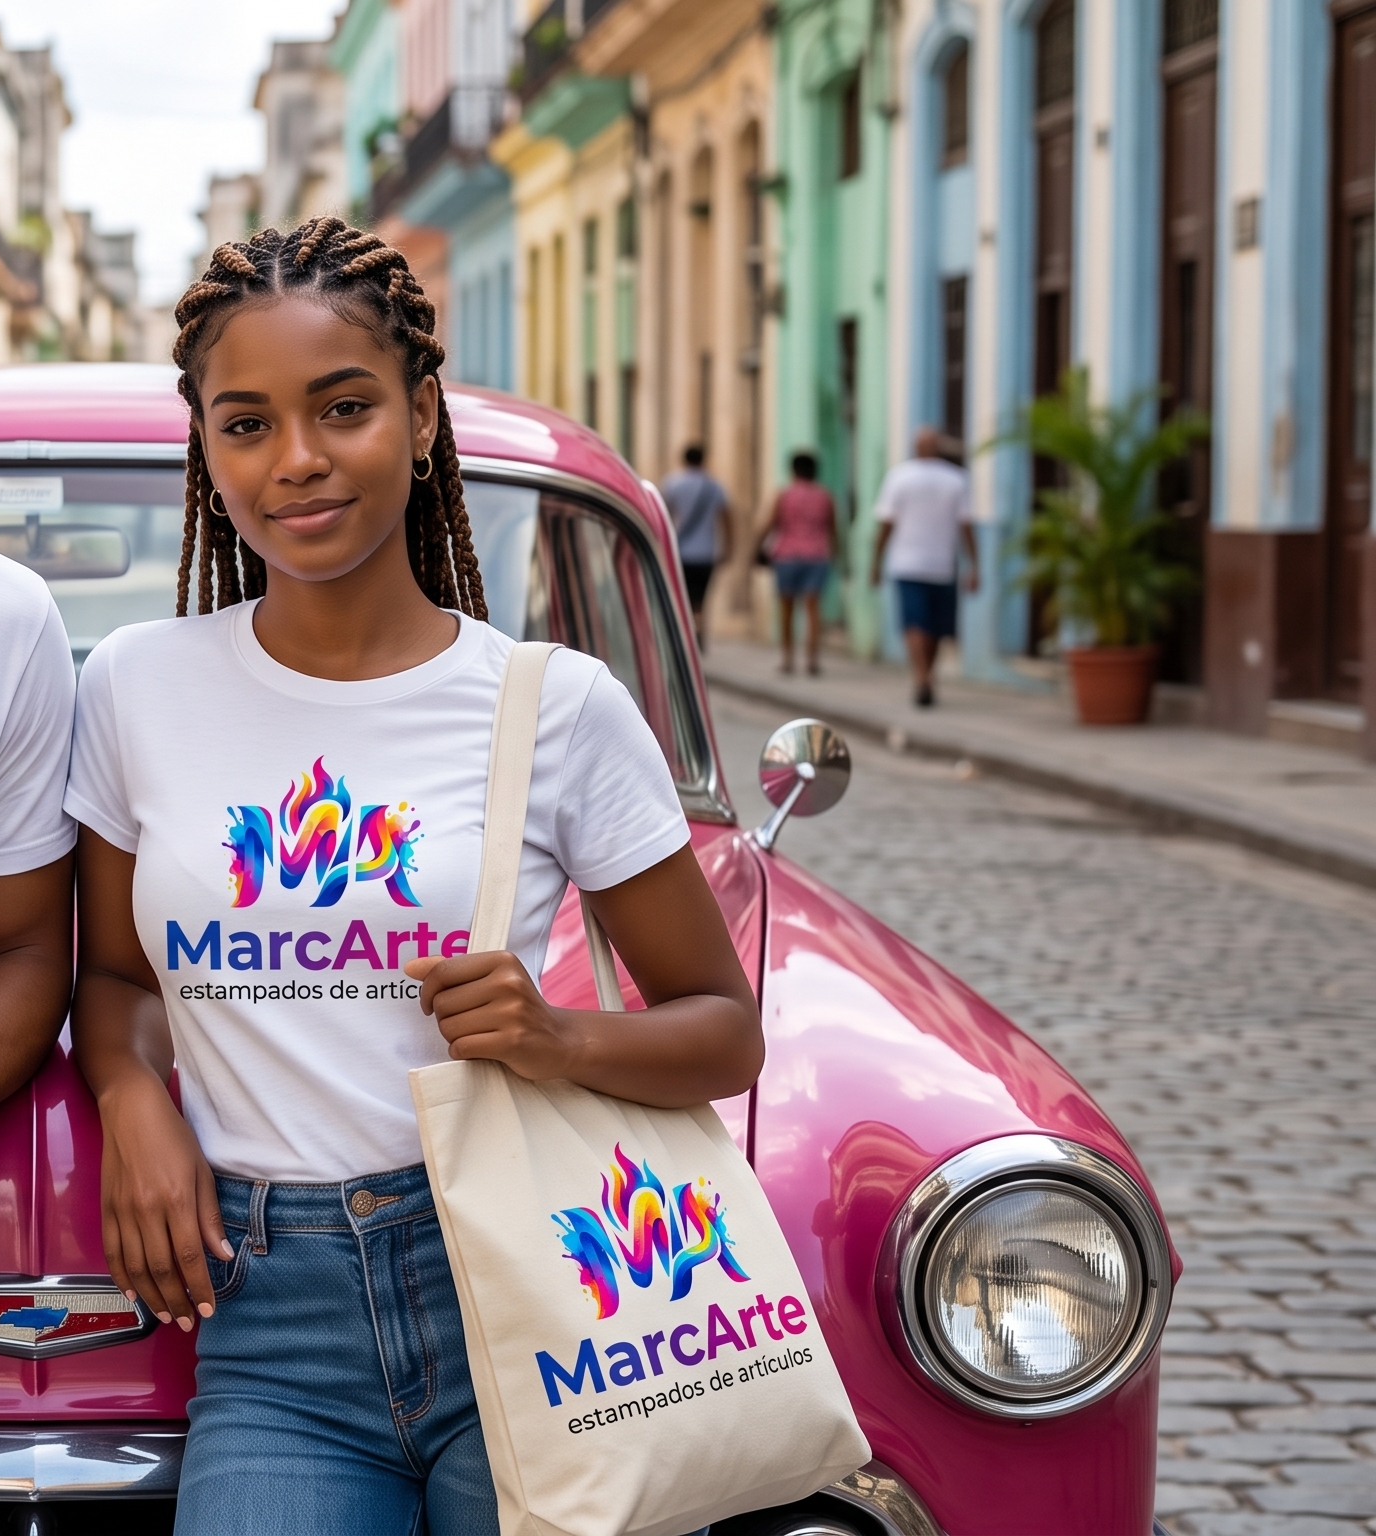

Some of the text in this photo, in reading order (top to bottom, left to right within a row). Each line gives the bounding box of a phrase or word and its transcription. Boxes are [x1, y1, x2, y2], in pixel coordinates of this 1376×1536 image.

[179, 979, 422, 1004] estampados de artíc
[535, 1293, 808, 1408] MarcArte
[567, 1347, 813, 1434] estampados de artículos
